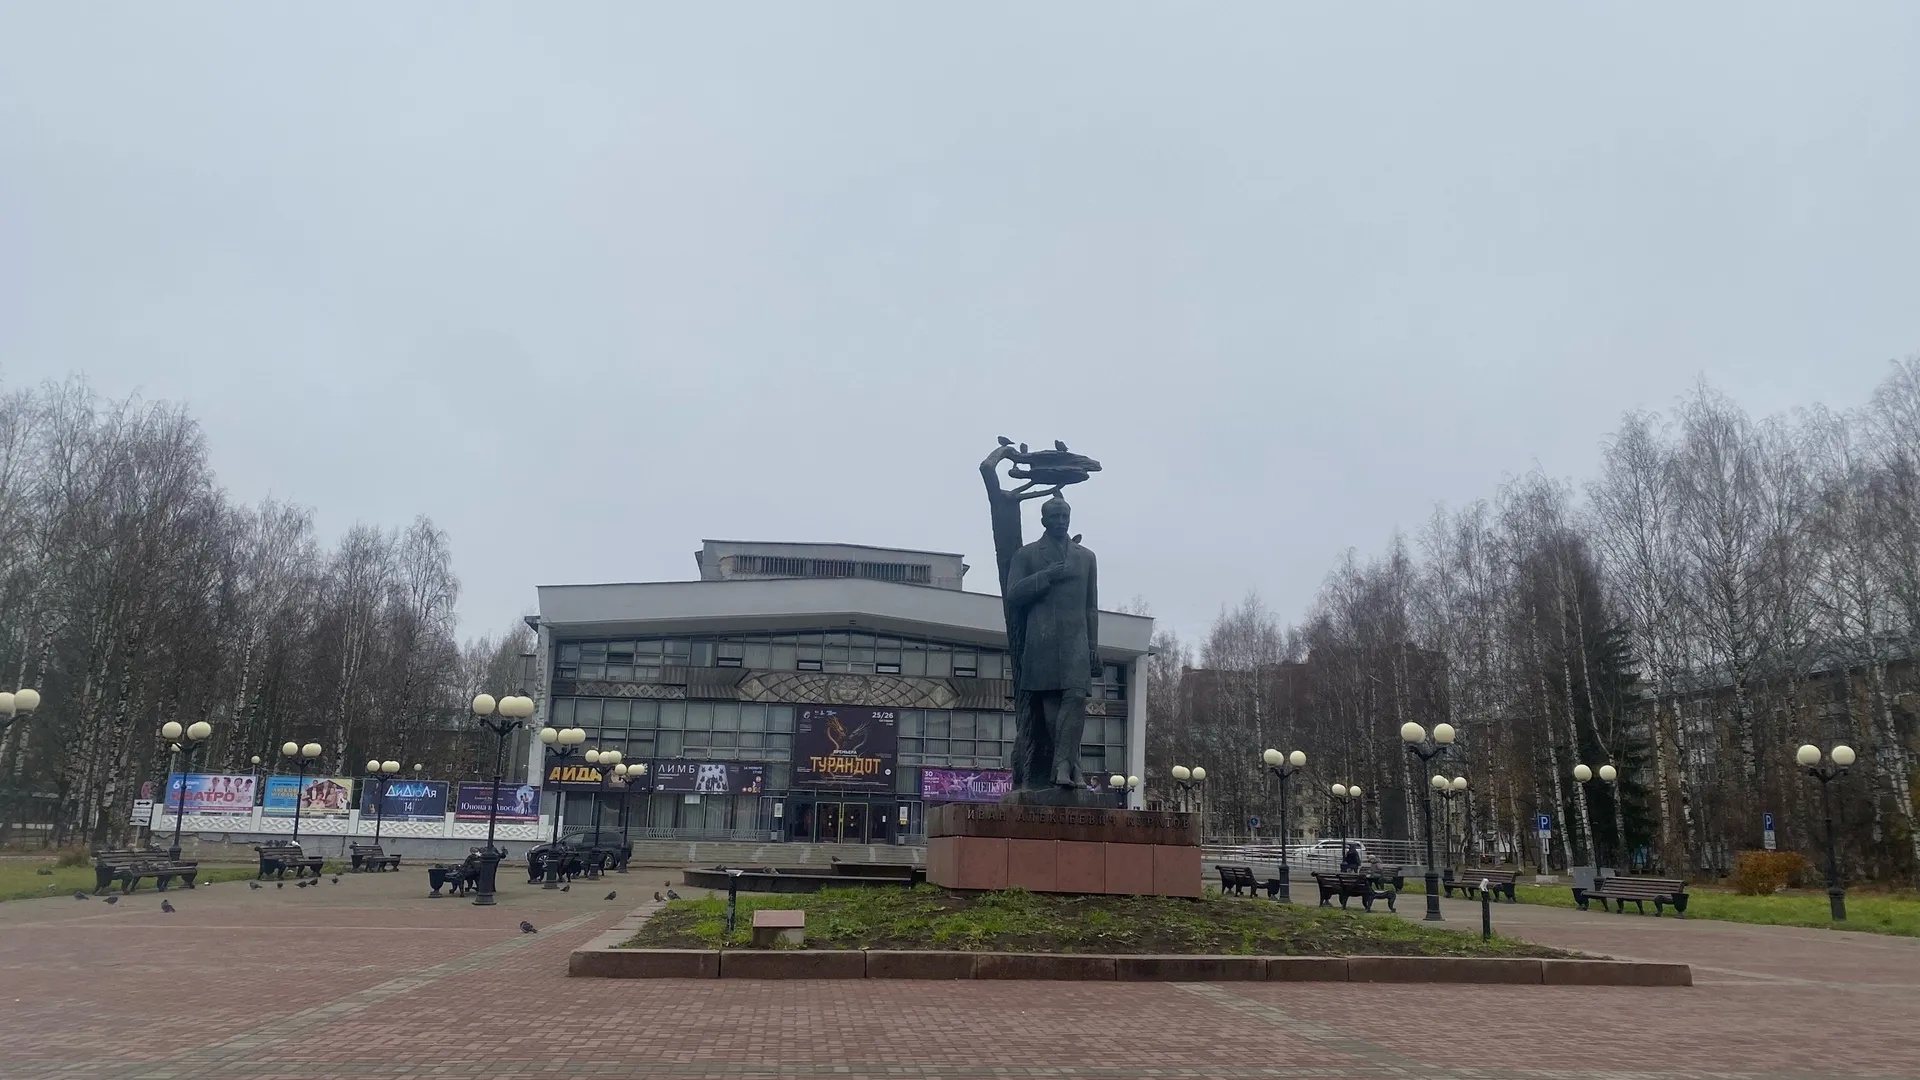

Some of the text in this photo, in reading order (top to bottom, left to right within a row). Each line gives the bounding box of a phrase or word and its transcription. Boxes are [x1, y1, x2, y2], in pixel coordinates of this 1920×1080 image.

[872, 711, 893, 720] 25/26
[658, 764, 695, 774] ЛИМБ
[810, 756, 881, 775] ТУРАНДОТ
[548, 766, 602, 782] АИДА
[172, 780, 180, 790] 6
[404, 802, 412, 811] 14
[461, 802, 487, 811] Юнона
[967, 809, 1006, 821] ИВАН
[1541, 816, 1548, 829] P
[1765, 814, 1772, 830] P
